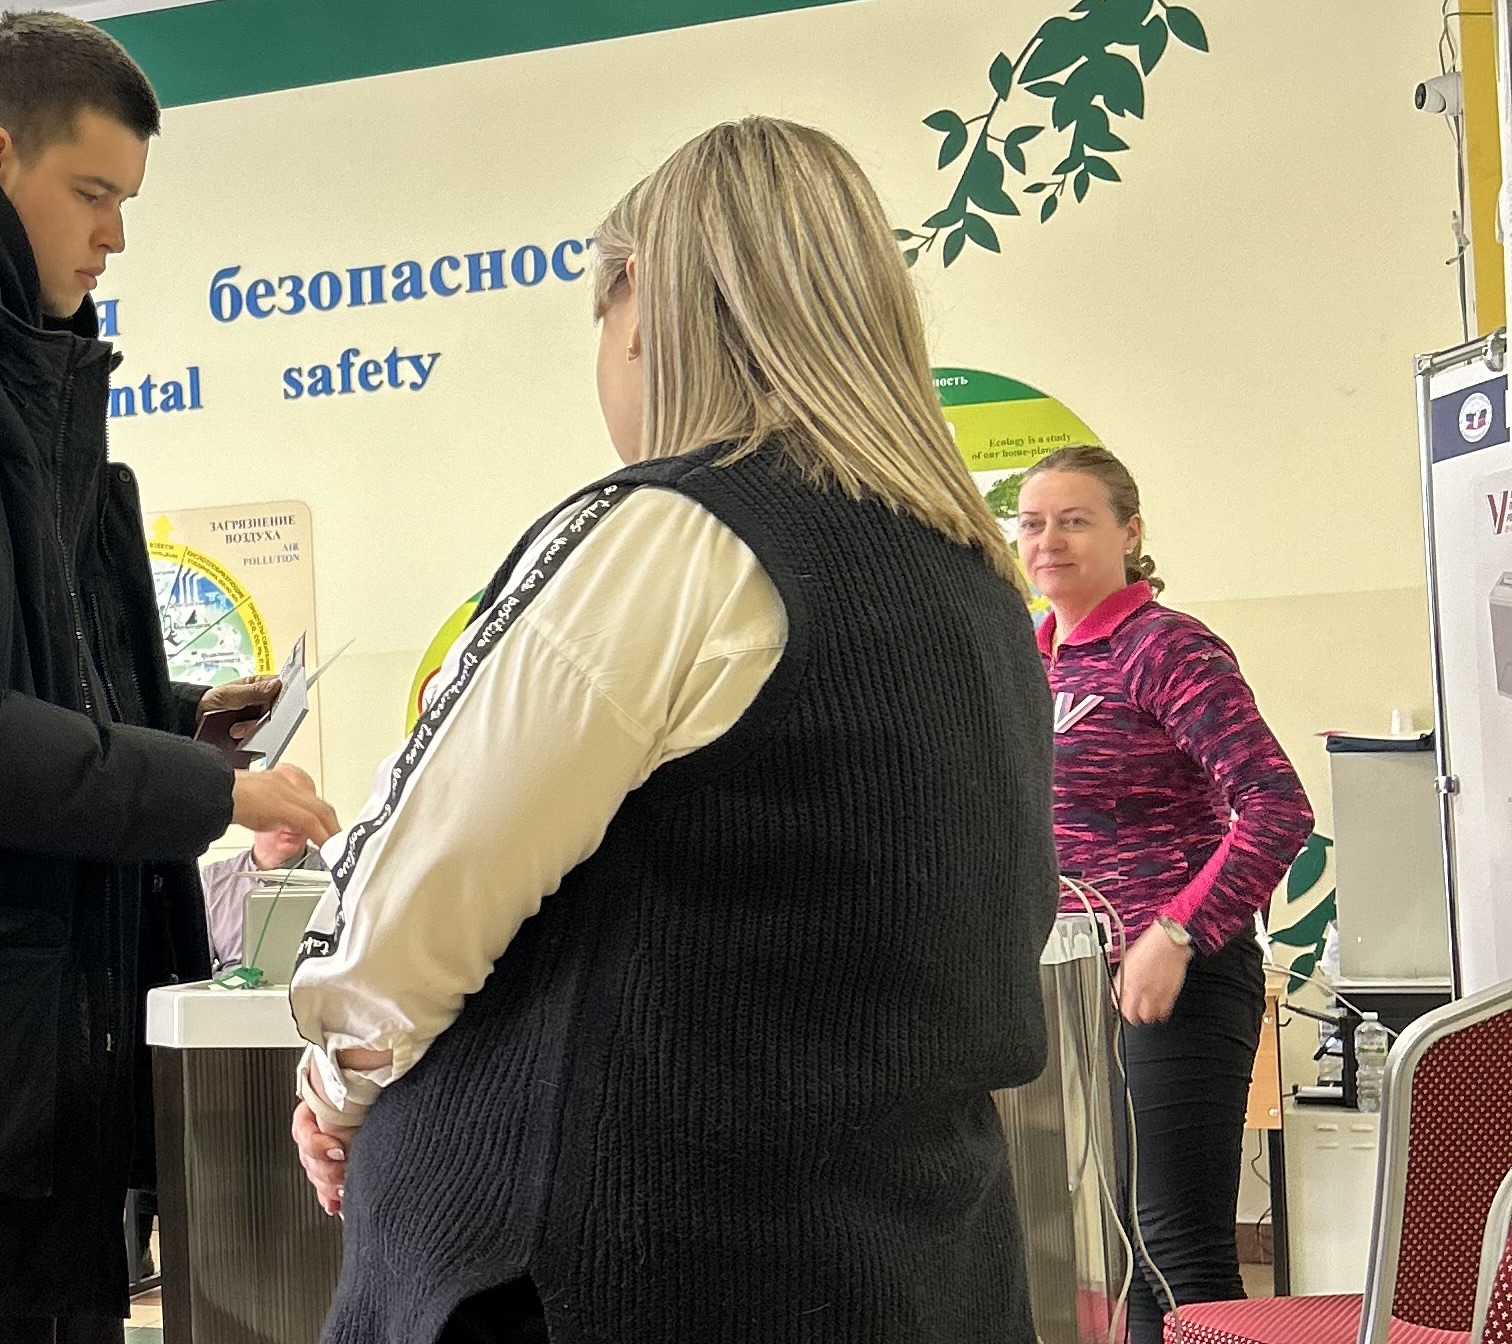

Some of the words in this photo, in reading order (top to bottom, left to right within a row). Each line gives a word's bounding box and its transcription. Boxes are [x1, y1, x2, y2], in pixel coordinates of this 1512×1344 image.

[283, 346, 441, 400] safety
[990, 438, 1024, 448] Ecology
[1028, 436, 1036, 444] is
[1046, 433, 1071, 443] study
[209, 515, 296, 532] ЗАГРЯЗНЕНИЕ
[570, 499, 611, 533] takes
[225, 530, 281, 544] ВОЗДУХА
[282, 542, 300, 552] AIR
[544, 537, 568, 565] you
[243, 553, 300, 567] POLLUTION
[477, 596, 520, 648] positive
[430, 652, 478, 720] thinking
[405, 723, 432, 765] takes
